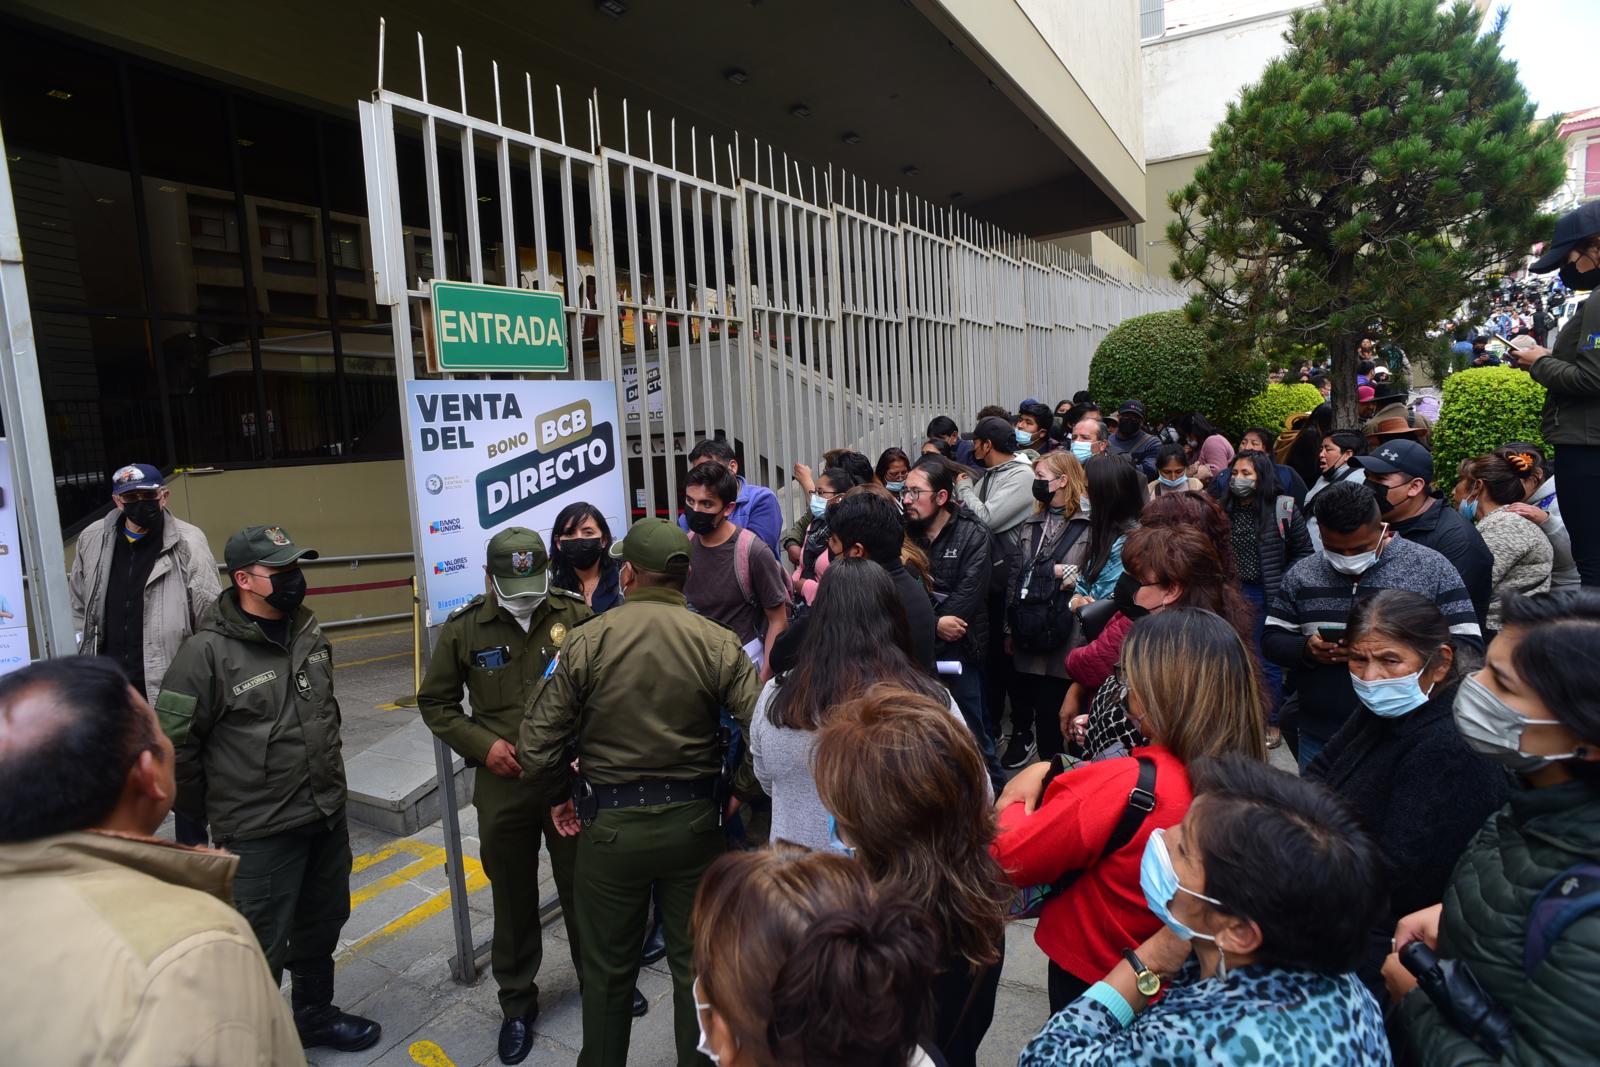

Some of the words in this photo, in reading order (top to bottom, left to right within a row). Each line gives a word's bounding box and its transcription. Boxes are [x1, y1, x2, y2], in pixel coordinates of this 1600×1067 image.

[440, 310, 563, 346] ENTRADA
[416, 393, 522, 422] VENTA
[420, 426, 474, 451] DEL
[487, 432, 528, 459] BONO
[541, 409, 587, 445] BCB
[487, 438, 607, 515] DIRECTO
[440, 518, 461, 526] BANCO
[444, 556, 468, 566] VALORES
